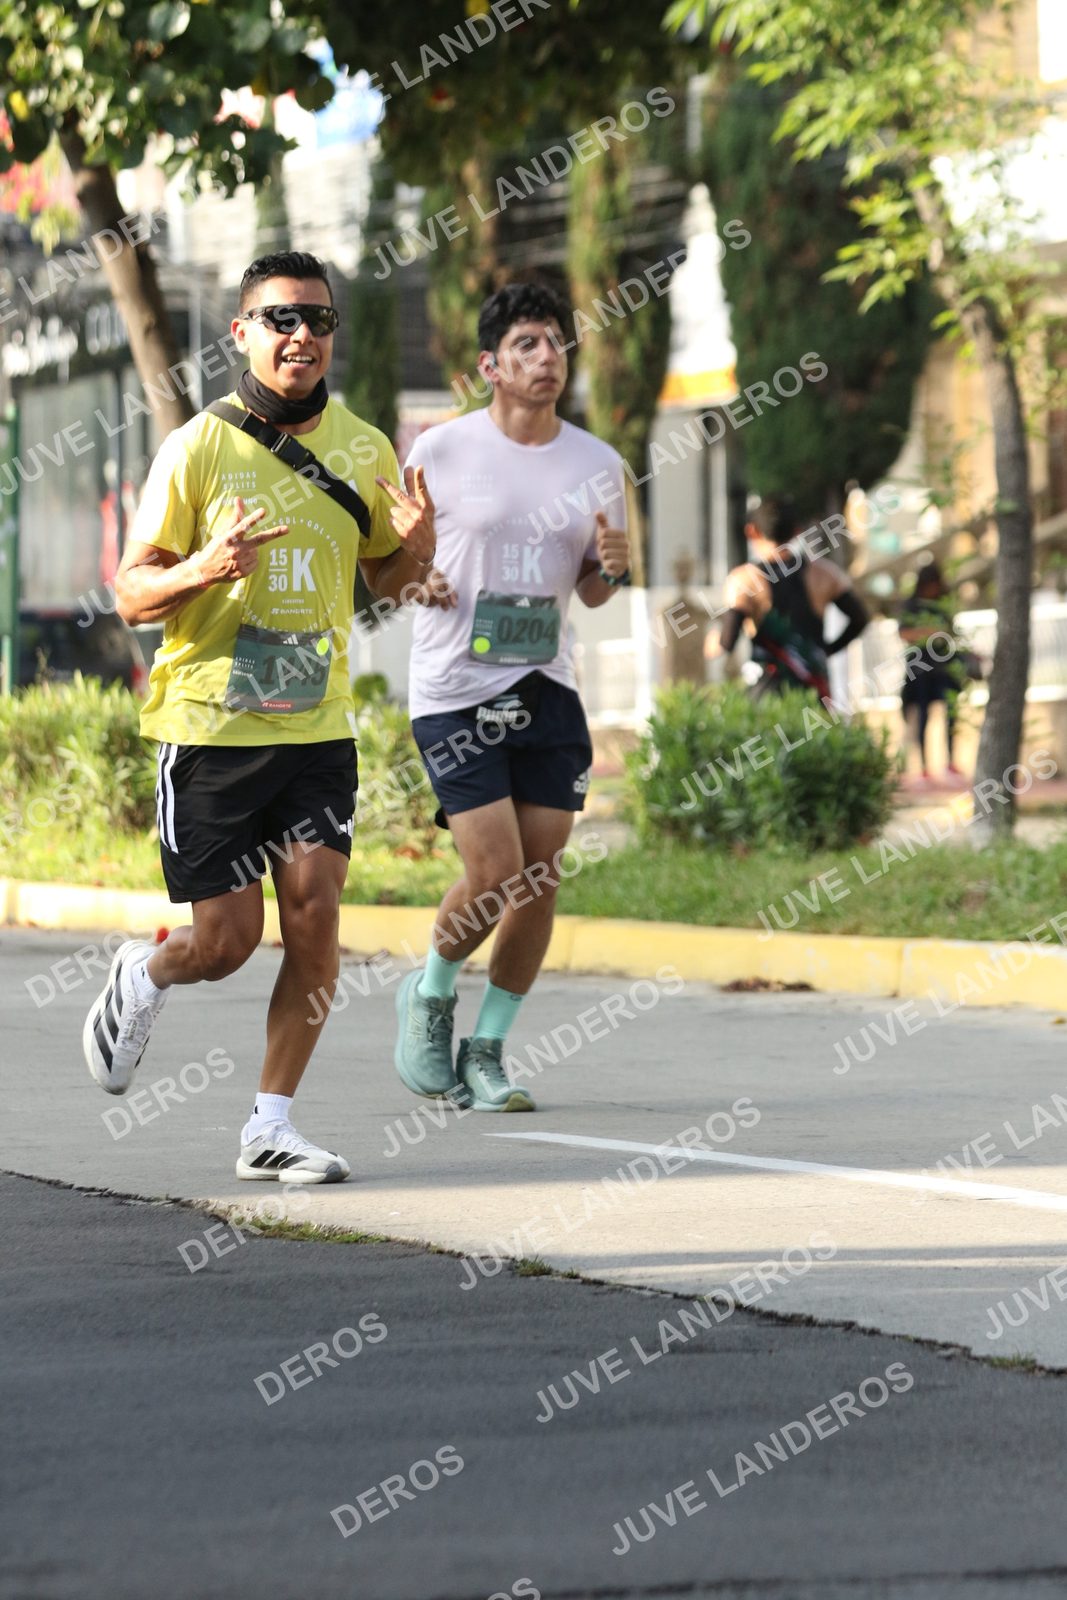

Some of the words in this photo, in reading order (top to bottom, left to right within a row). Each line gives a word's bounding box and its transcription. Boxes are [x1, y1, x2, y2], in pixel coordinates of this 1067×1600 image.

[269, 548, 288, 566] 15
[503, 544, 519, 558] 15
[293, 548, 317, 592] K
[502, 566, 519, 581] 30
[523, 545, 544, 584] K
[268, 574, 288, 592] 30
[497, 615, 558, 645] 0204
